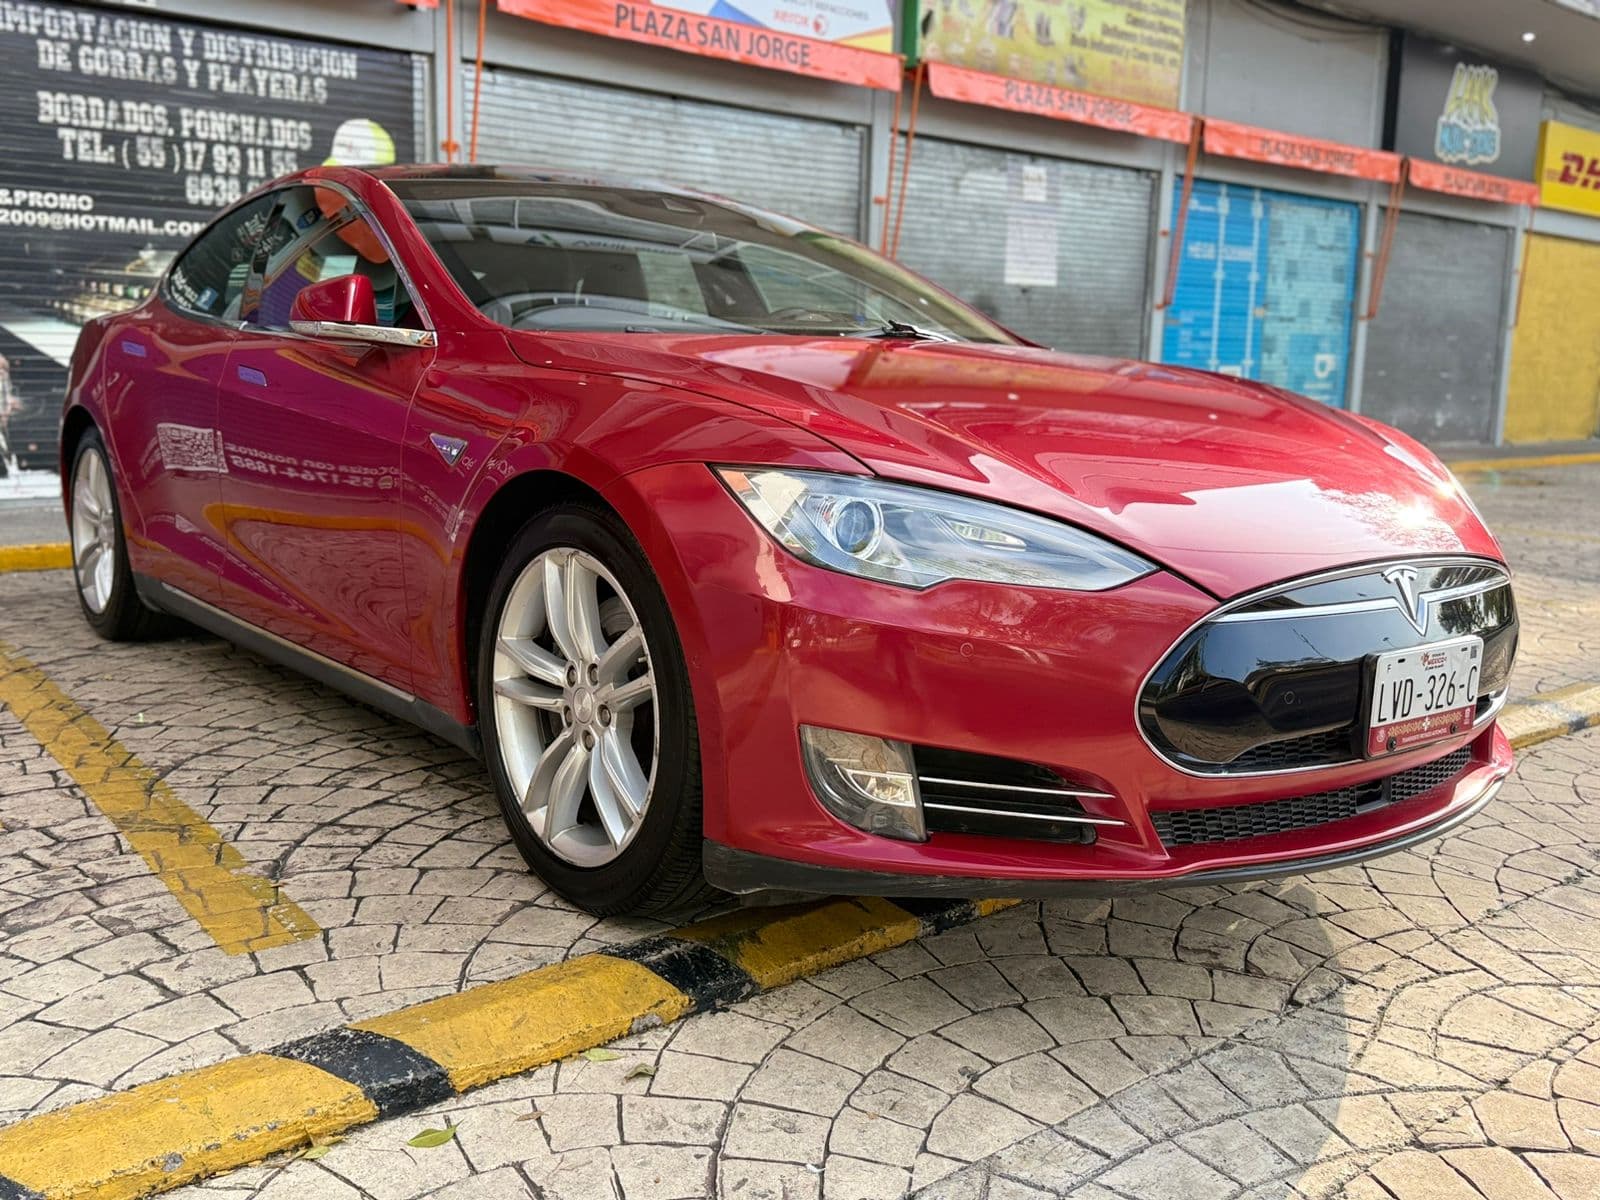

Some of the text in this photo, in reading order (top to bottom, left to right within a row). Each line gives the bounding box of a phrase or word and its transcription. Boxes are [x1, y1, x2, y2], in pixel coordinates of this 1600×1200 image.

[178, 28, 195, 57] Y
[202, 31, 358, 80] DISTRIBUCION
[614, 4, 812, 66] PLAZA SAN JORGE
[36, 39, 328, 104] DE GORRAS Y PLAYERAS
[1004, 79, 1054, 107] PLAZA
[57, 127, 116, 163] TEL:
[212, 143, 241, 175] 93
[247, 147, 266, 178] 11
[180, 108, 313, 151] PONCHADOS
[0, 188, 94, 211] &PROMO
[1377, 665, 1478, 723] LVD-326-C
